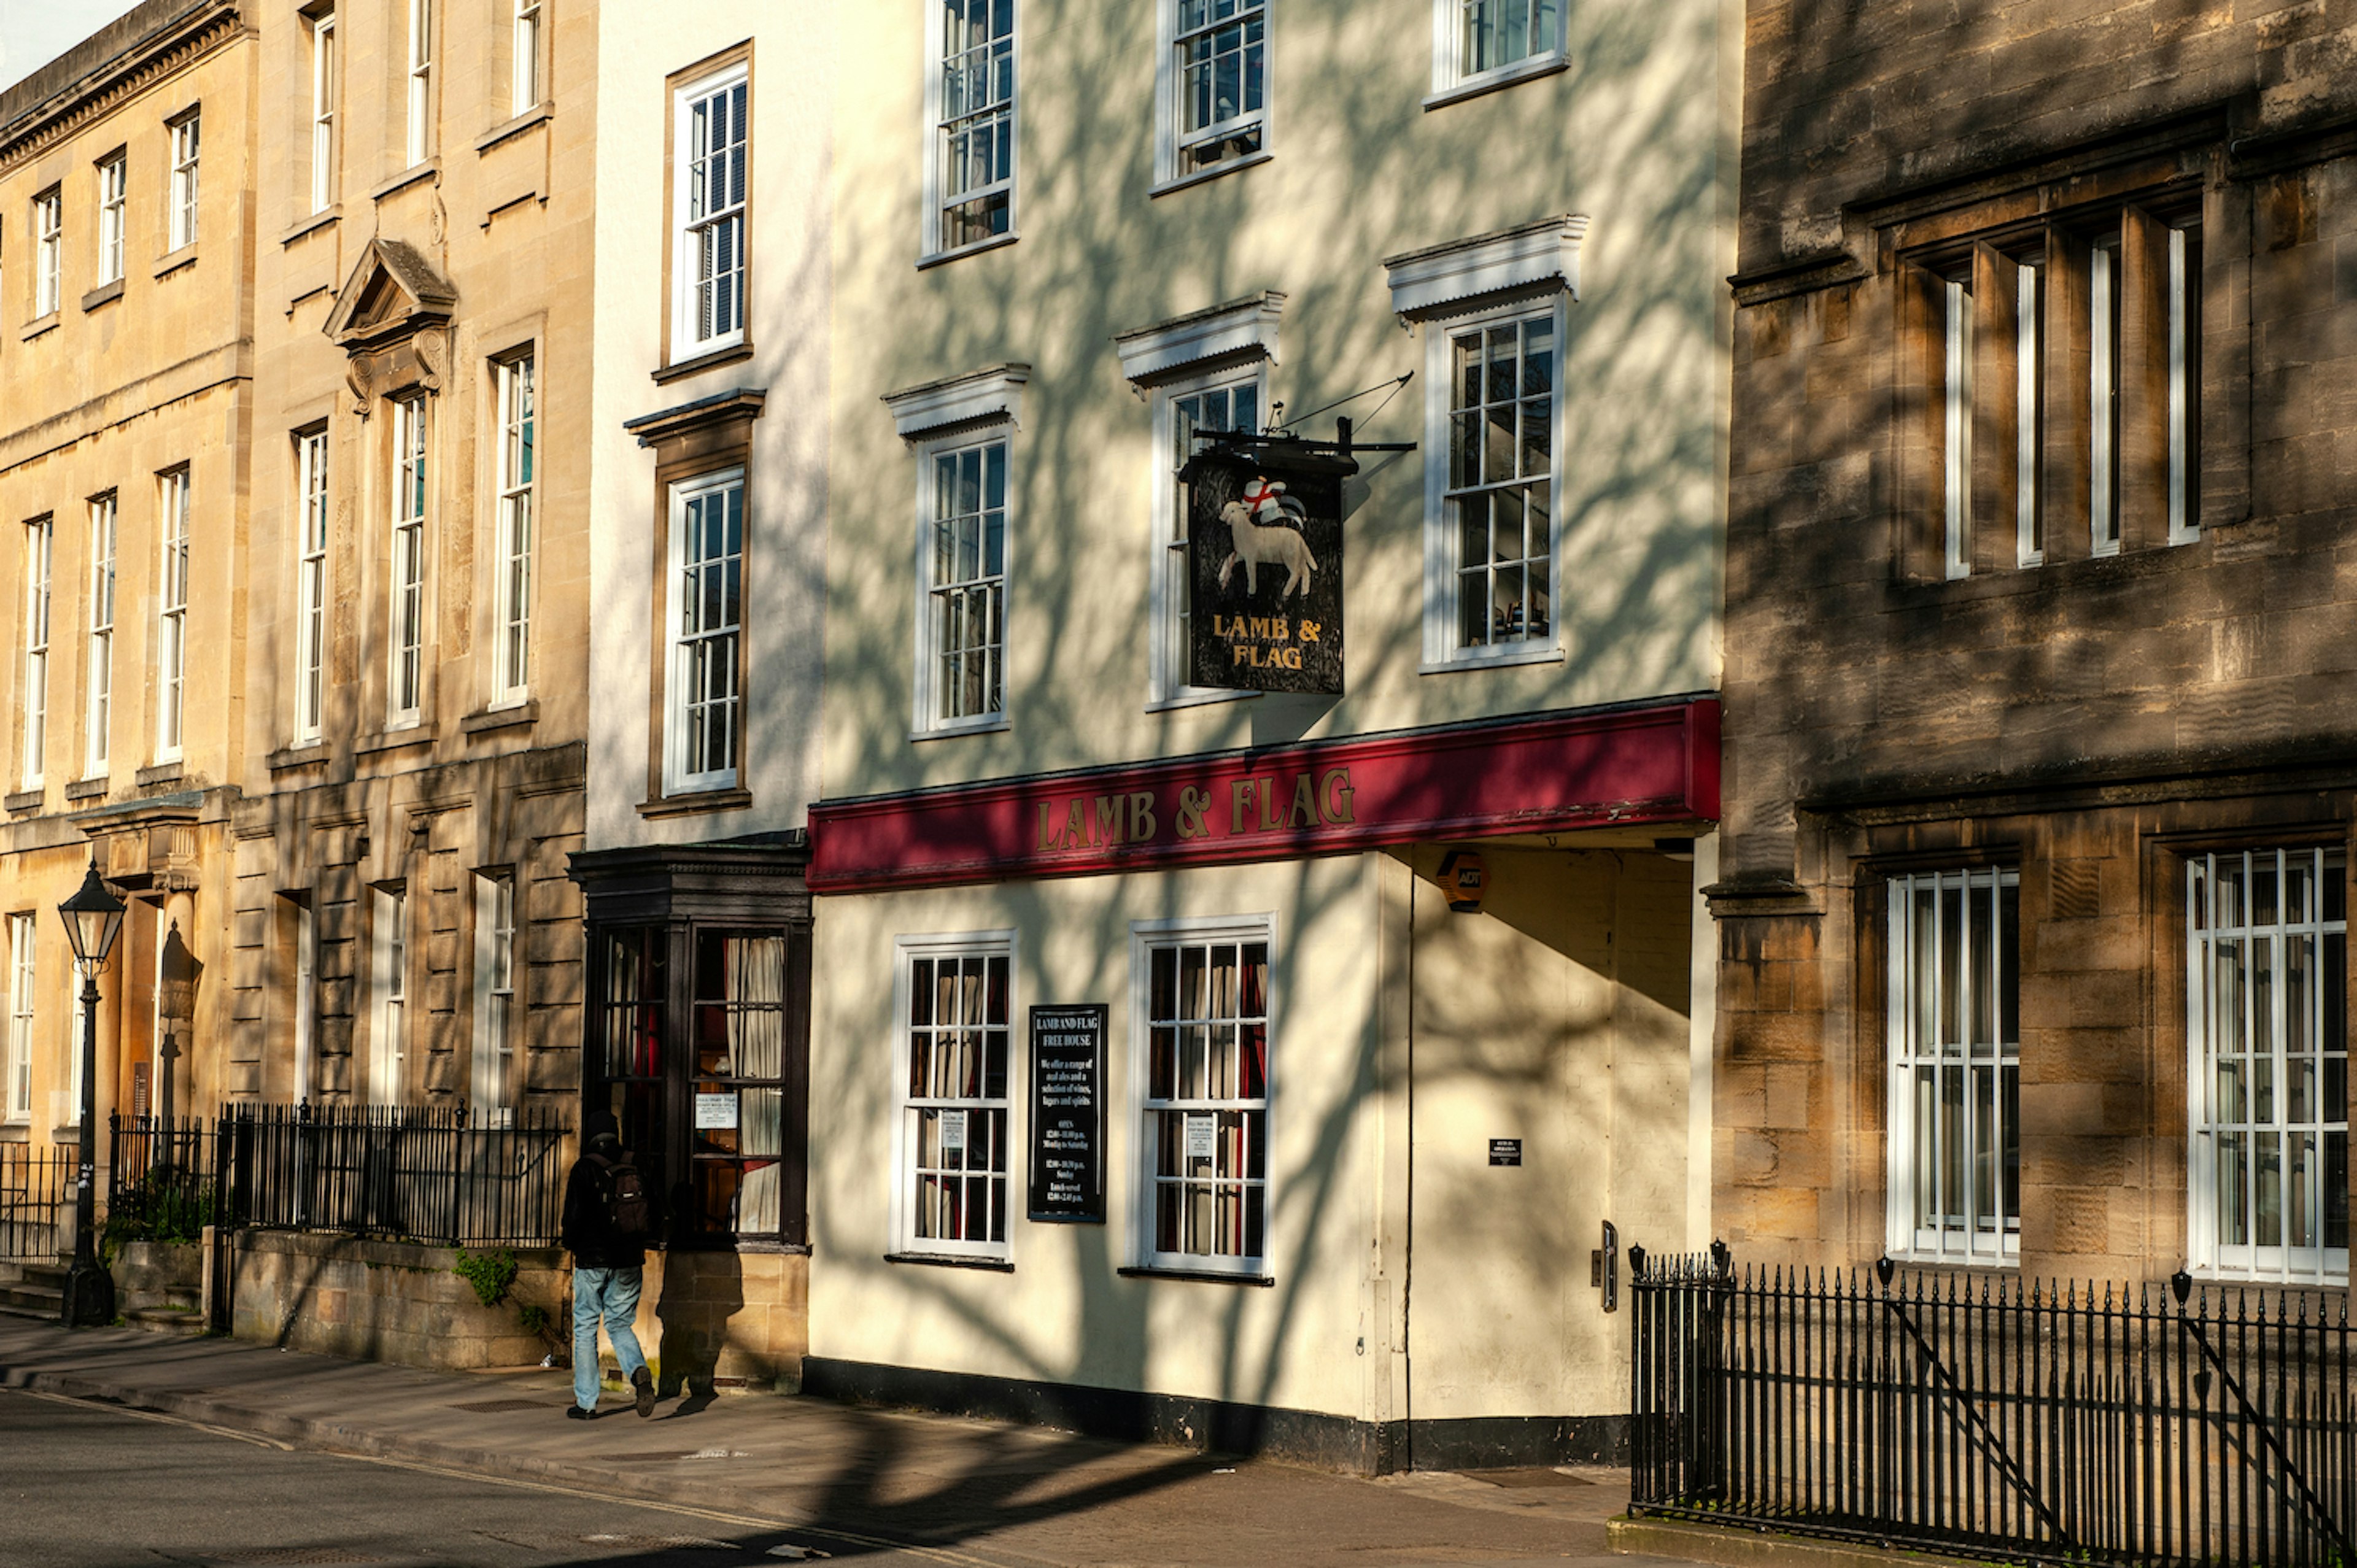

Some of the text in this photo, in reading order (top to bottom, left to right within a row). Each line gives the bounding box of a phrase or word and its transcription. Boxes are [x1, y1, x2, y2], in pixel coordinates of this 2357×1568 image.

[1213, 614, 1322, 643] LAMB &
[1234, 644, 1302, 670] FLAG
[1037, 767, 1355, 851] LAMB & FLAG
[1459, 871, 1480, 884] ADT
[1036, 1017, 1097, 1030] LAMB AND FLAG
[1043, 1033, 1091, 1047] FREE HOUSE
[1041, 1059, 1050, 1069] We
[1085, 1059, 1093, 1069] of
[1070, 1072, 1082, 1081] and
